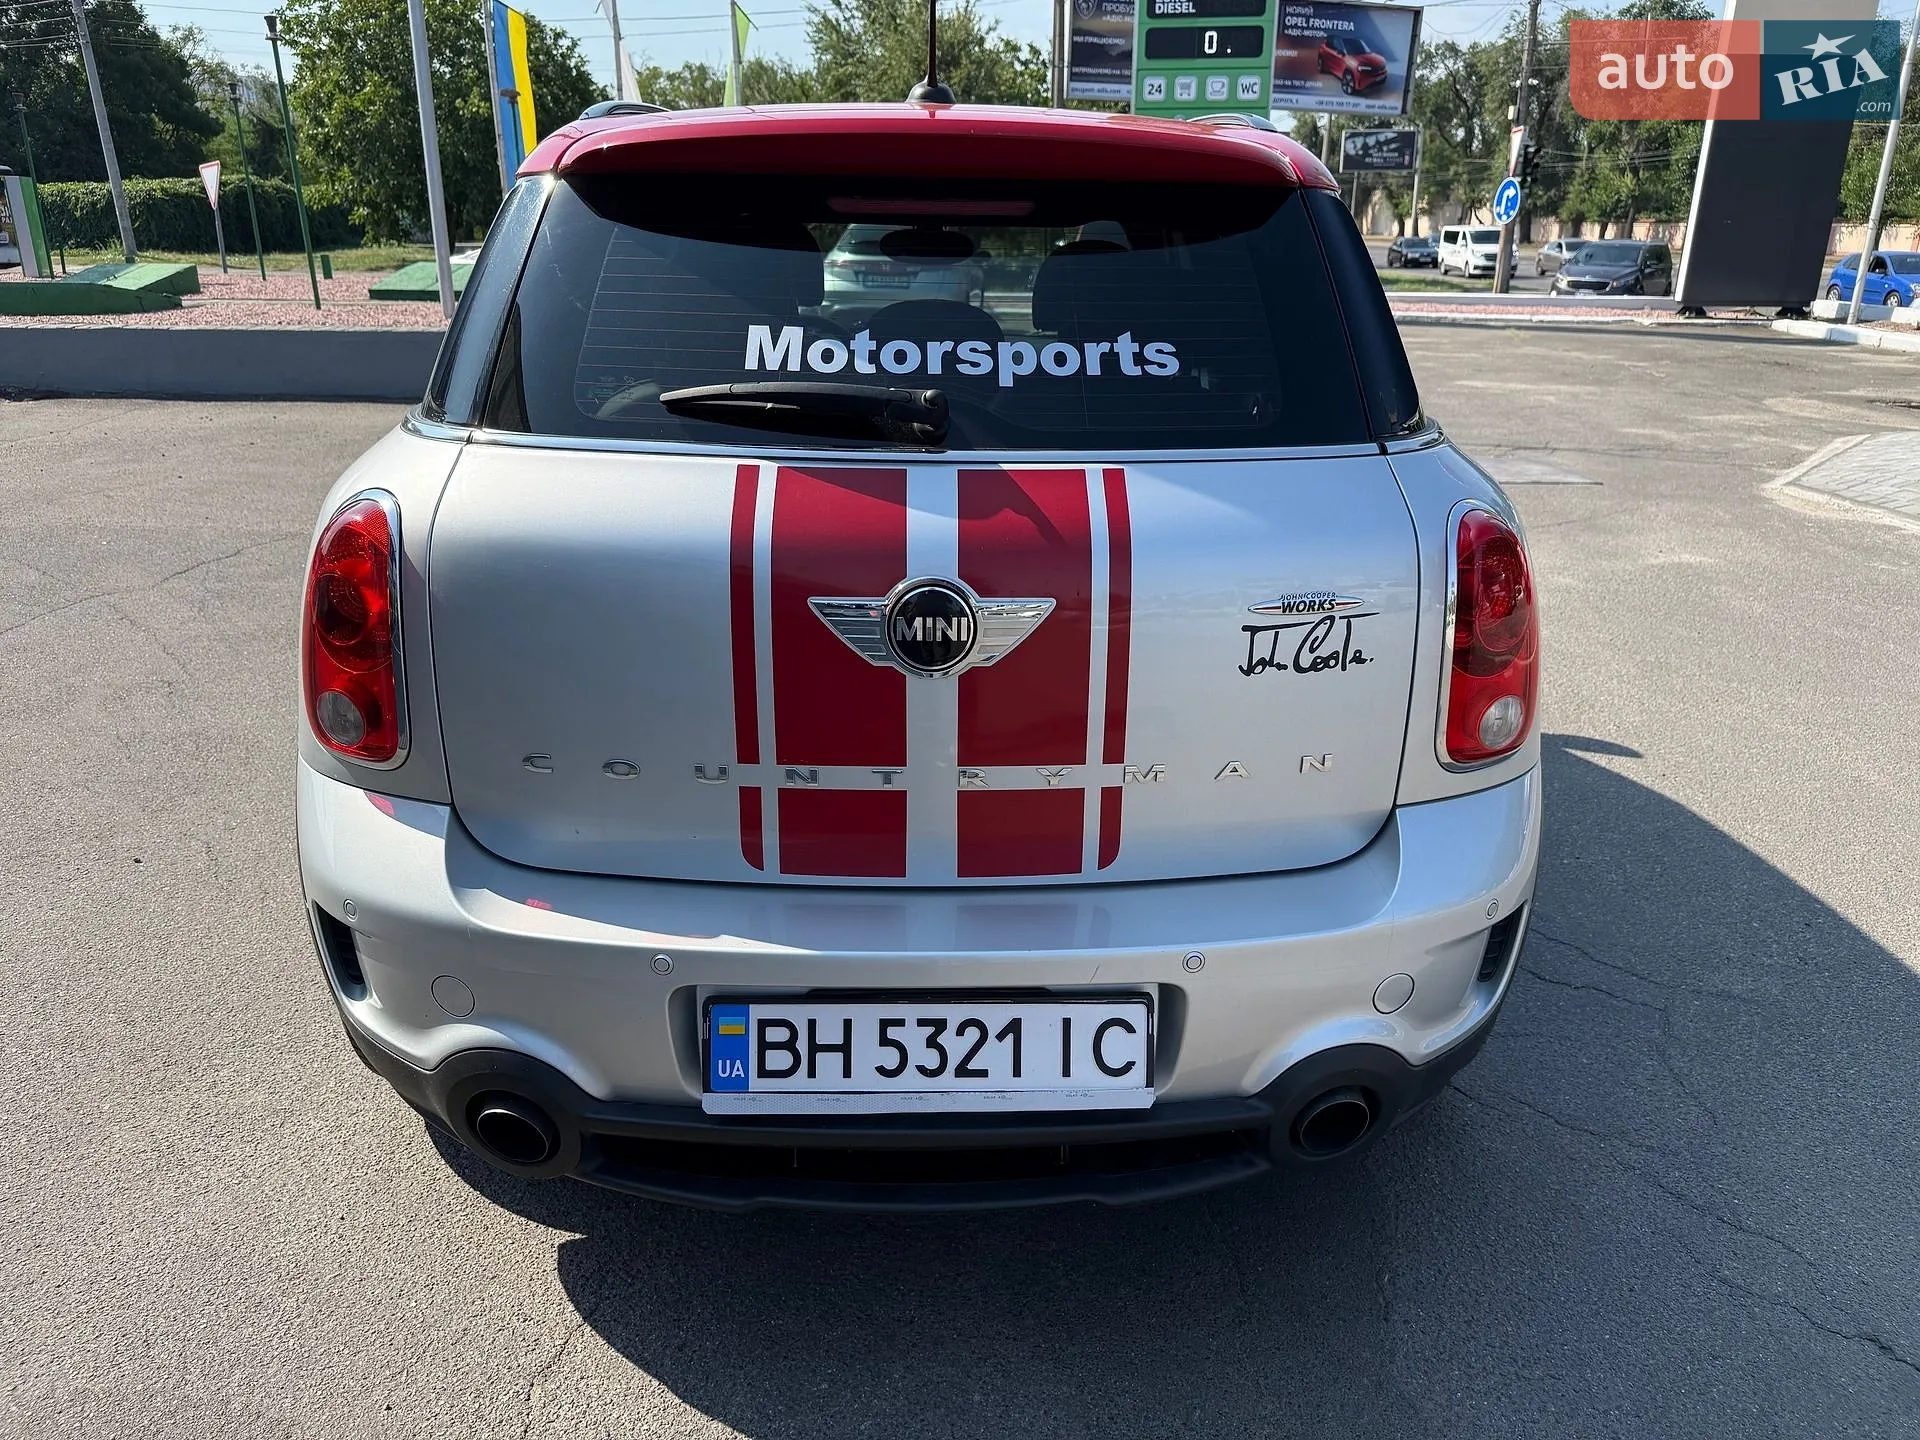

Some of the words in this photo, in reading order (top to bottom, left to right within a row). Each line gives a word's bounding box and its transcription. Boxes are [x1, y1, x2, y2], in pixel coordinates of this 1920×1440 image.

[1155, 2, 1196, 14] DIESEL
[1285, 16, 1307, 28] OPEL
[1309, 18, 1355, 31] FRONTERA
[1147, 83, 1162, 96] 24
[1241, 82, 1258, 95] WC
[744, 324, 1180, 388] Motorsports
[1306, 592, 1337, 600] COOPER
[1281, 600, 1337, 613] WORKS
[896, 616, 968, 641] MINI
[522, 753, 1333, 788] COUNTRYMAN
[718, 1059, 745, 1078] UA
[756, 1018, 852, 1079] BH
[874, 1017, 1021, 1079] 5321
[1061, 1017, 1137, 1078] IC
